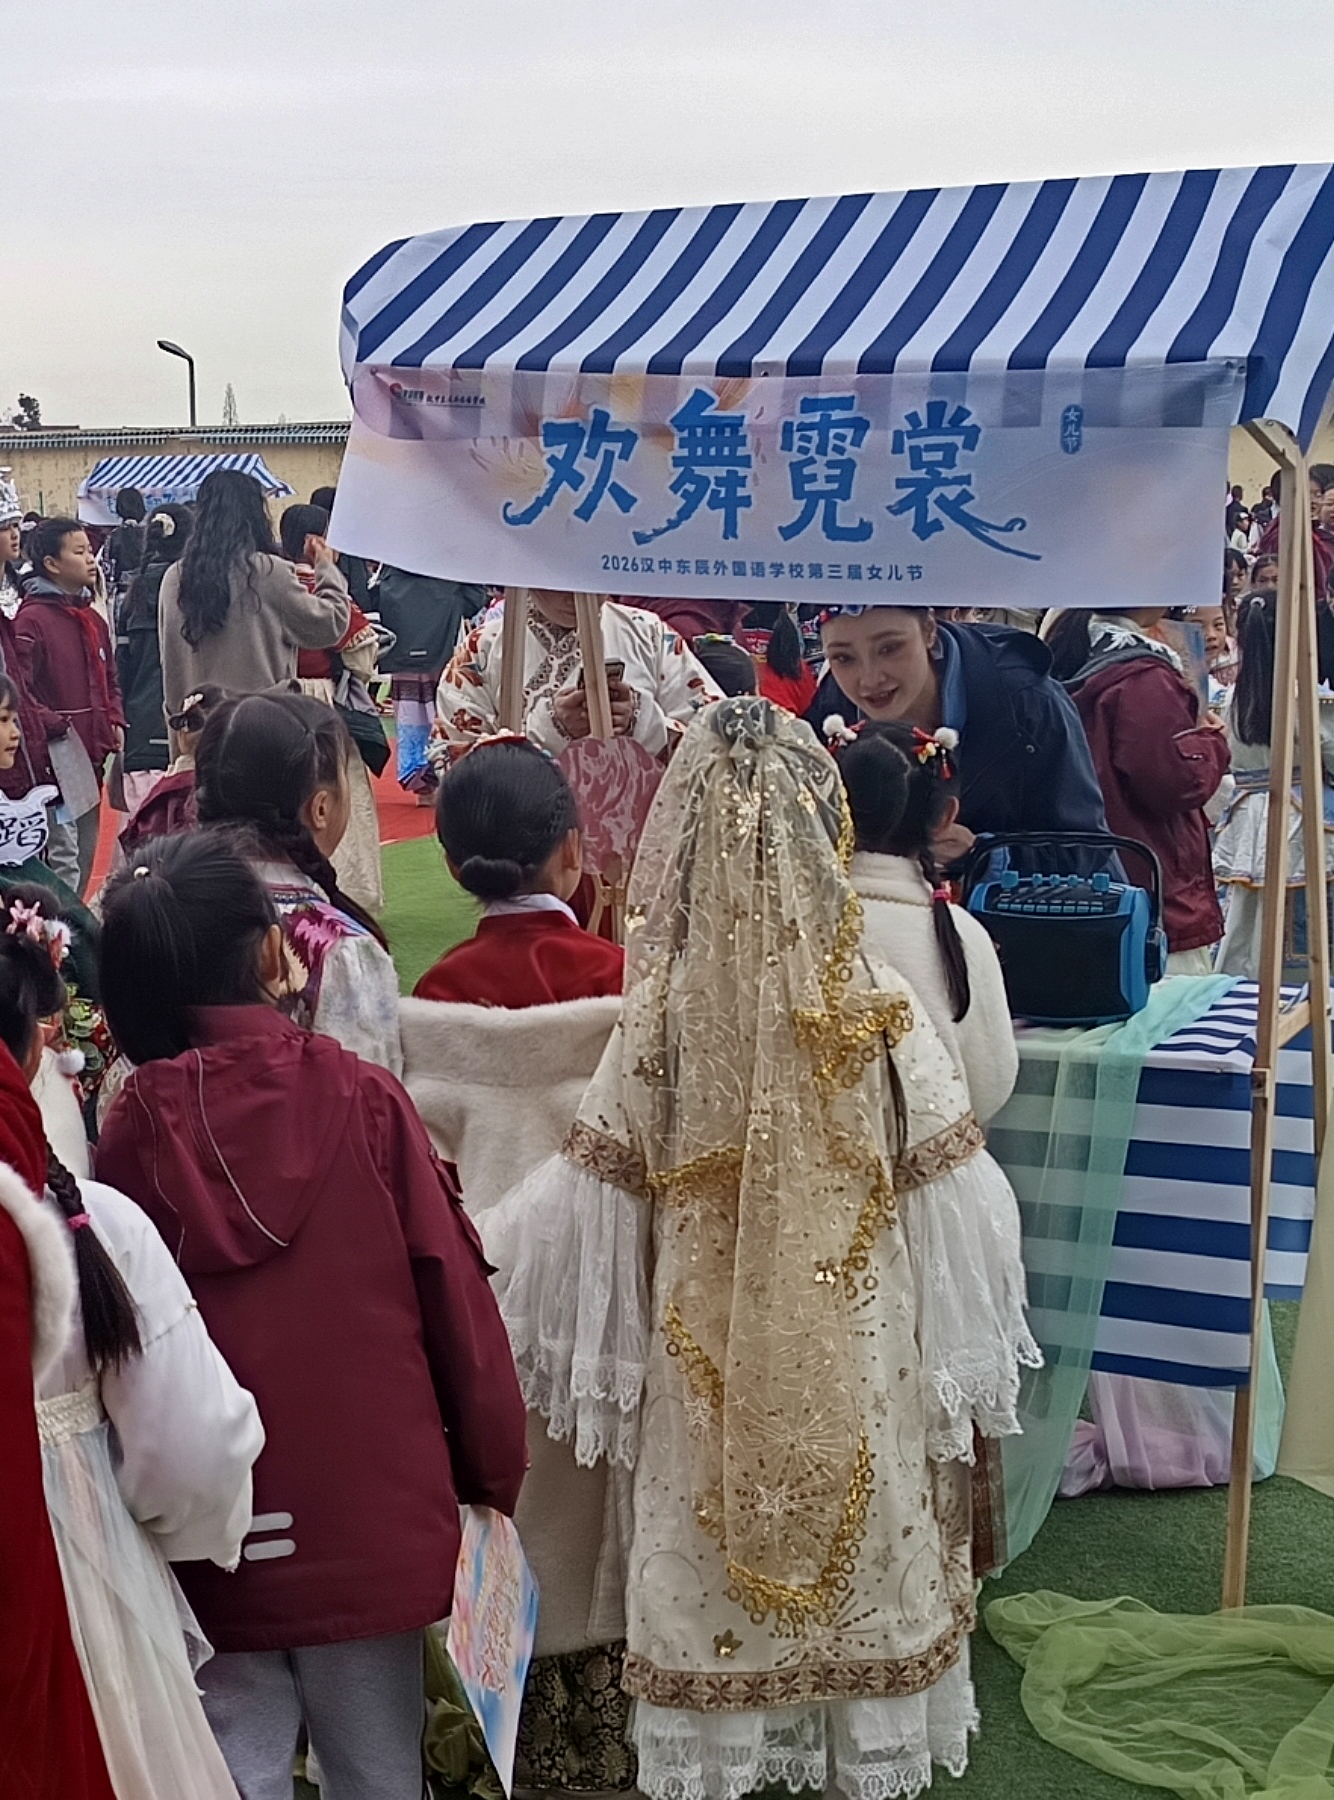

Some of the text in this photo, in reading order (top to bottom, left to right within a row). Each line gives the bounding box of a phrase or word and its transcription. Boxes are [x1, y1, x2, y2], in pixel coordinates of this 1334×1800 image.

[1063, 406, 1081, 453] 女儿节
[502, 388, 1042, 561] 欢舞霓裳
[601, 554, 924, 582] 2026汉中东辰外国语学校第三届女儿节
